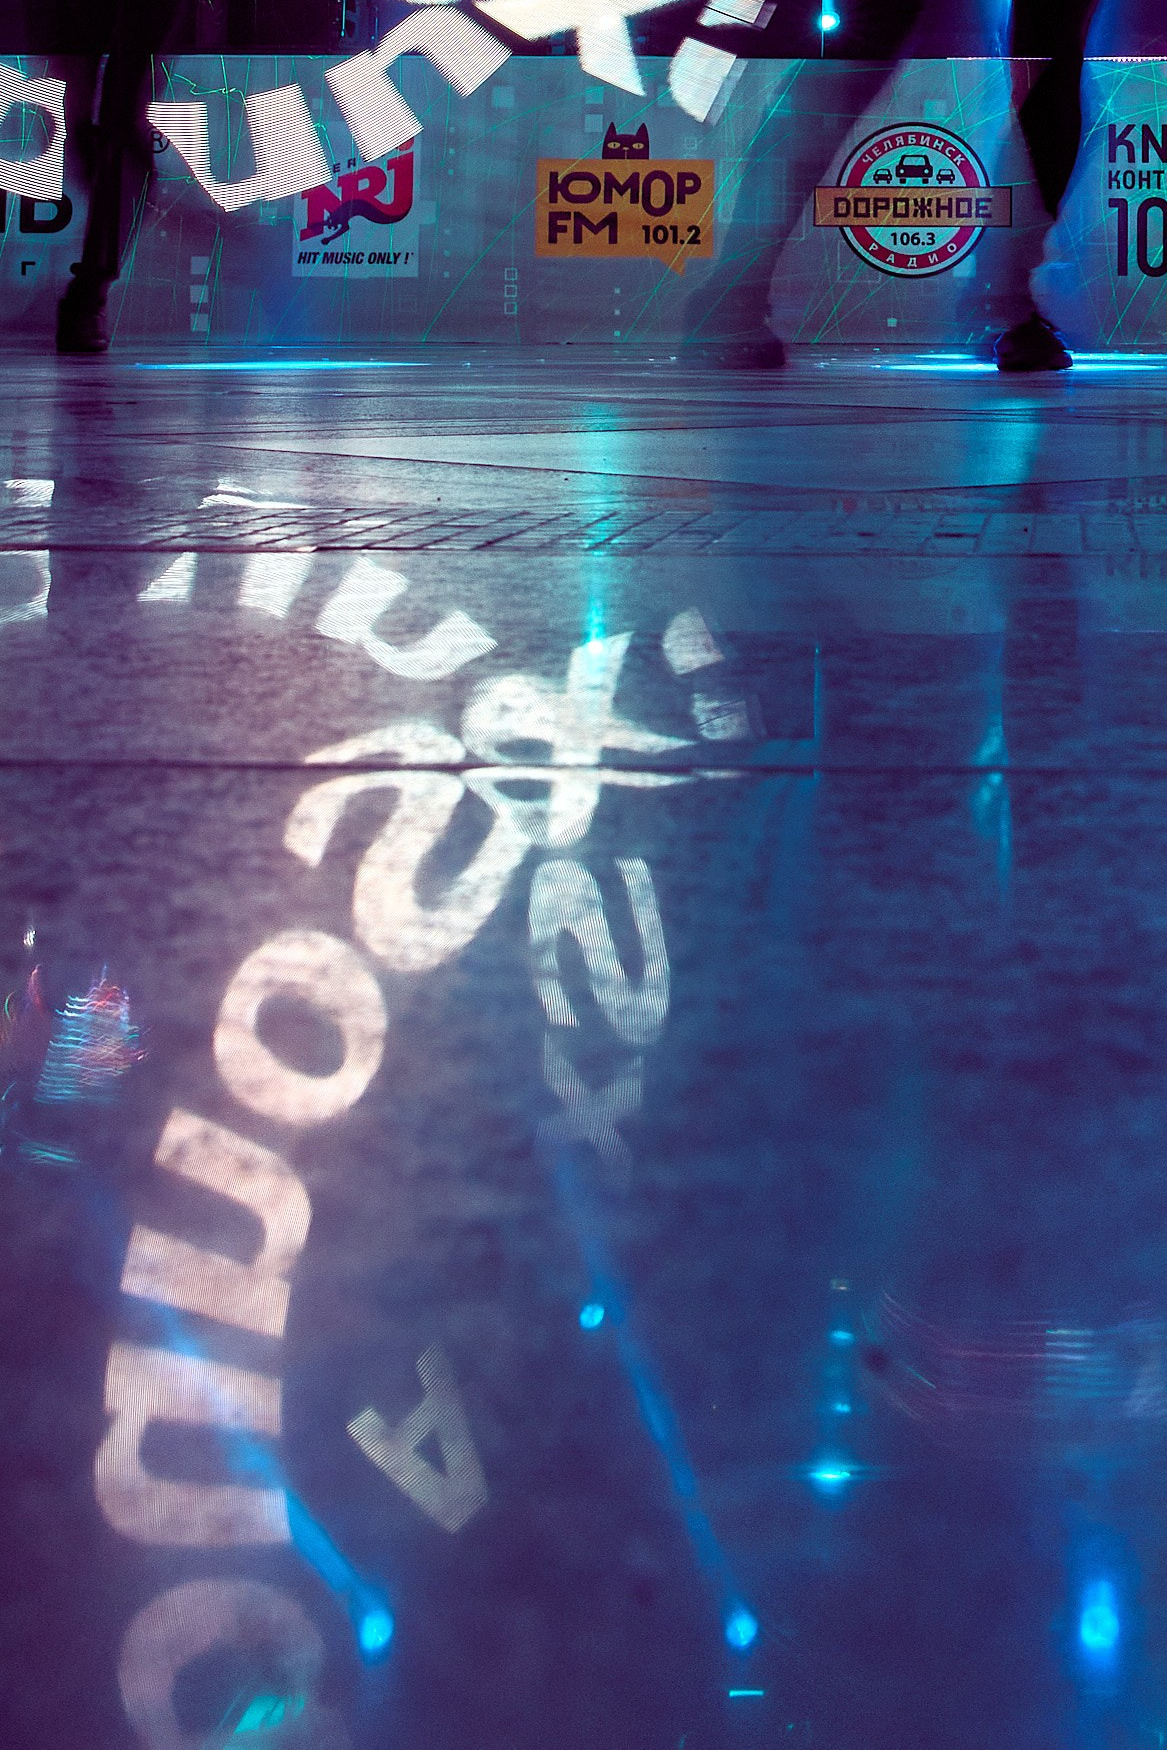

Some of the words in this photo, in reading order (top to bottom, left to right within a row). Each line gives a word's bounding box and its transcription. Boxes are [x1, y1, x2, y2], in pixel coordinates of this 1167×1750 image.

[862, 134, 966, 167] ЧЕЛЯБИНСК
[300, 138, 415, 244] NRJ
[549, 169, 701, 217] ЮМОР
[834, 198, 993, 218] ДОРОЖНОЕ
[549, 212, 618, 244] FM
[642, 225, 701, 245] 101.2
[890, 232, 936, 246] 106.3
[297, 252, 320, 265] HIT
[322, 252, 364, 265] MUSIC
[367, 252, 402, 265] ONLY
[868, 242, 957, 267] РАДИО
